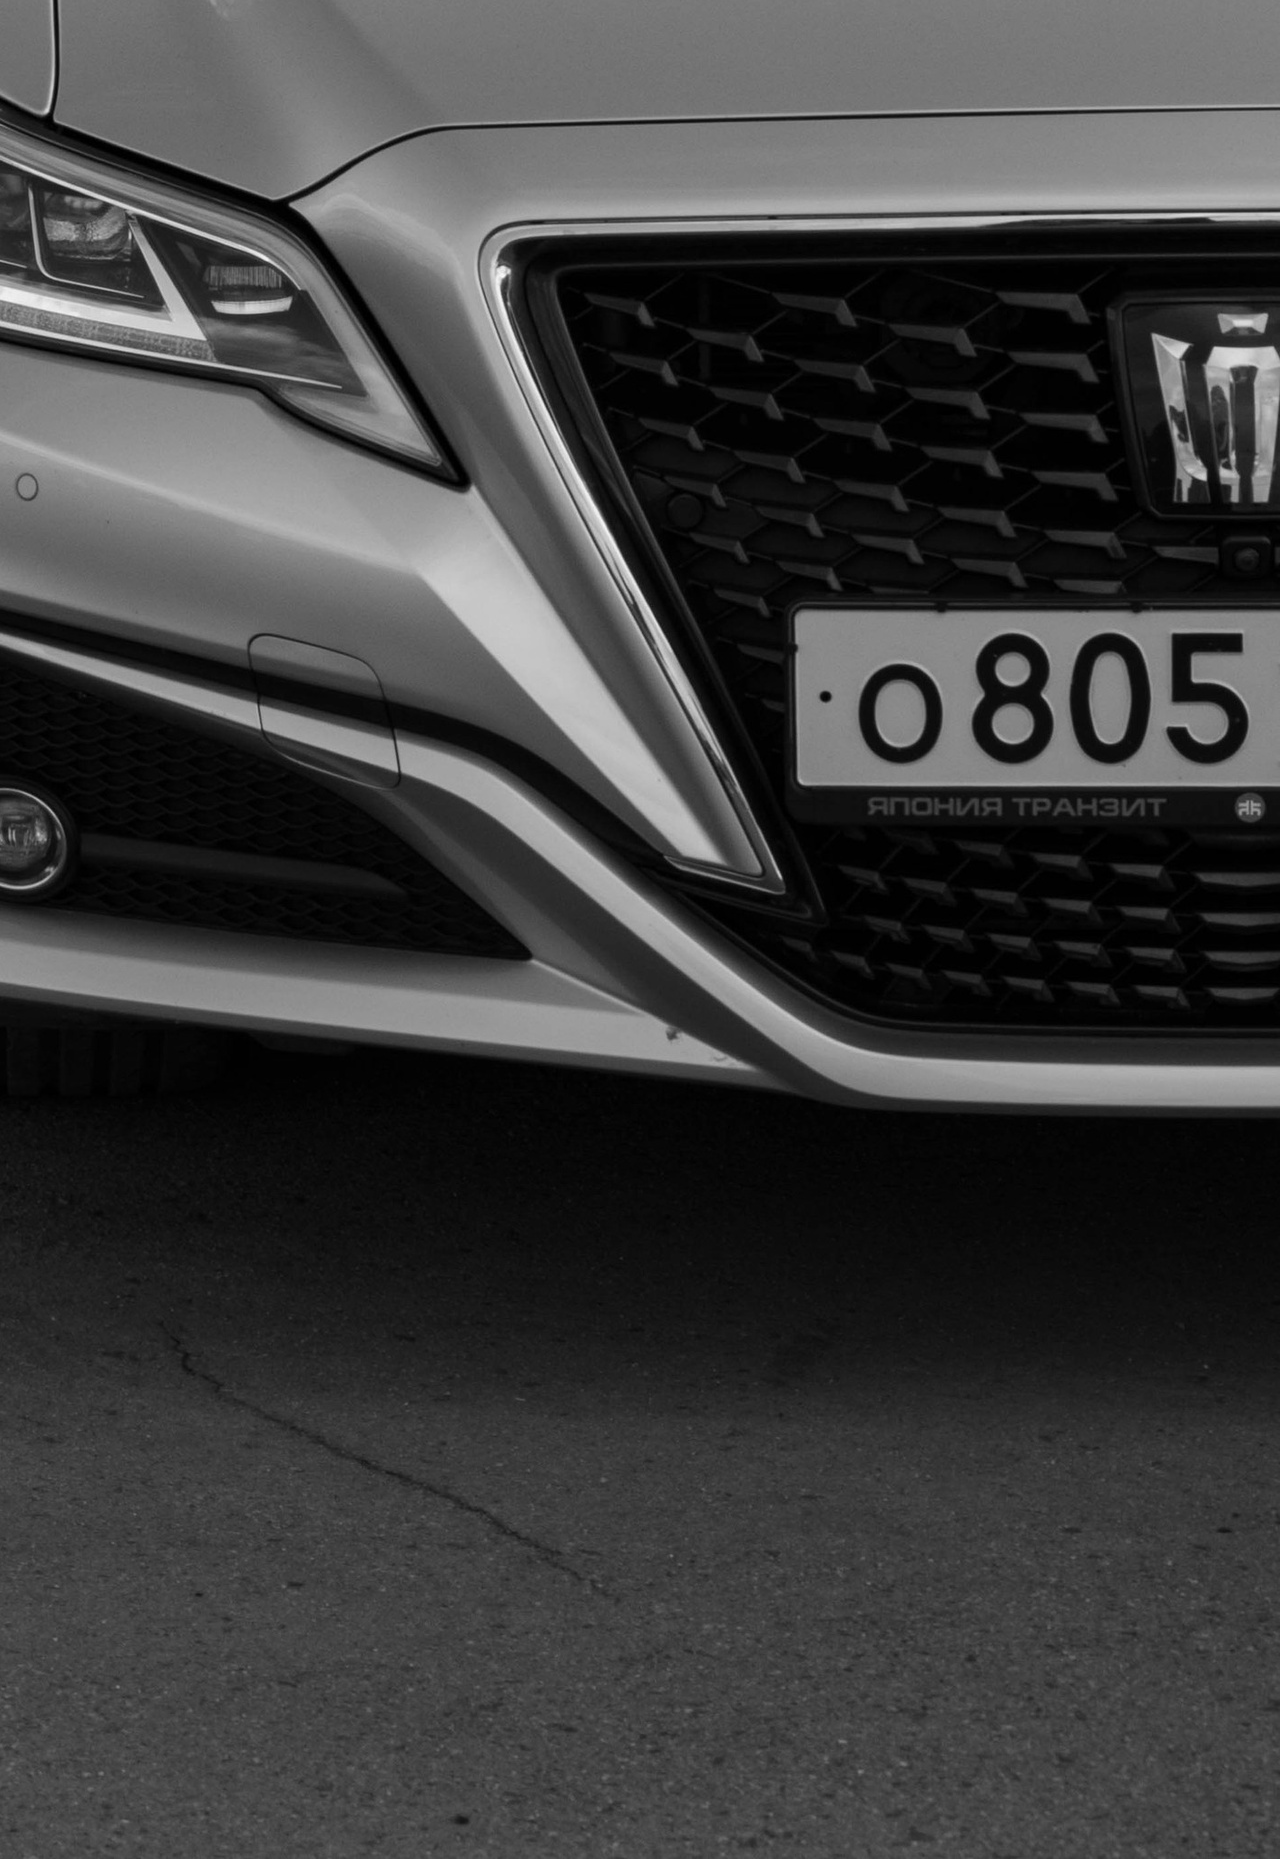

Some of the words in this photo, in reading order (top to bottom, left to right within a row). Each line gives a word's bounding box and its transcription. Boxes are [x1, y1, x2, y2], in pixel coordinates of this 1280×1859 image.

[858, 632, 1249, 764] О805
[867, 796, 1003, 817] ЯПОНИЯ
[1011, 797, 1168, 817] ТРАНЗИТ
